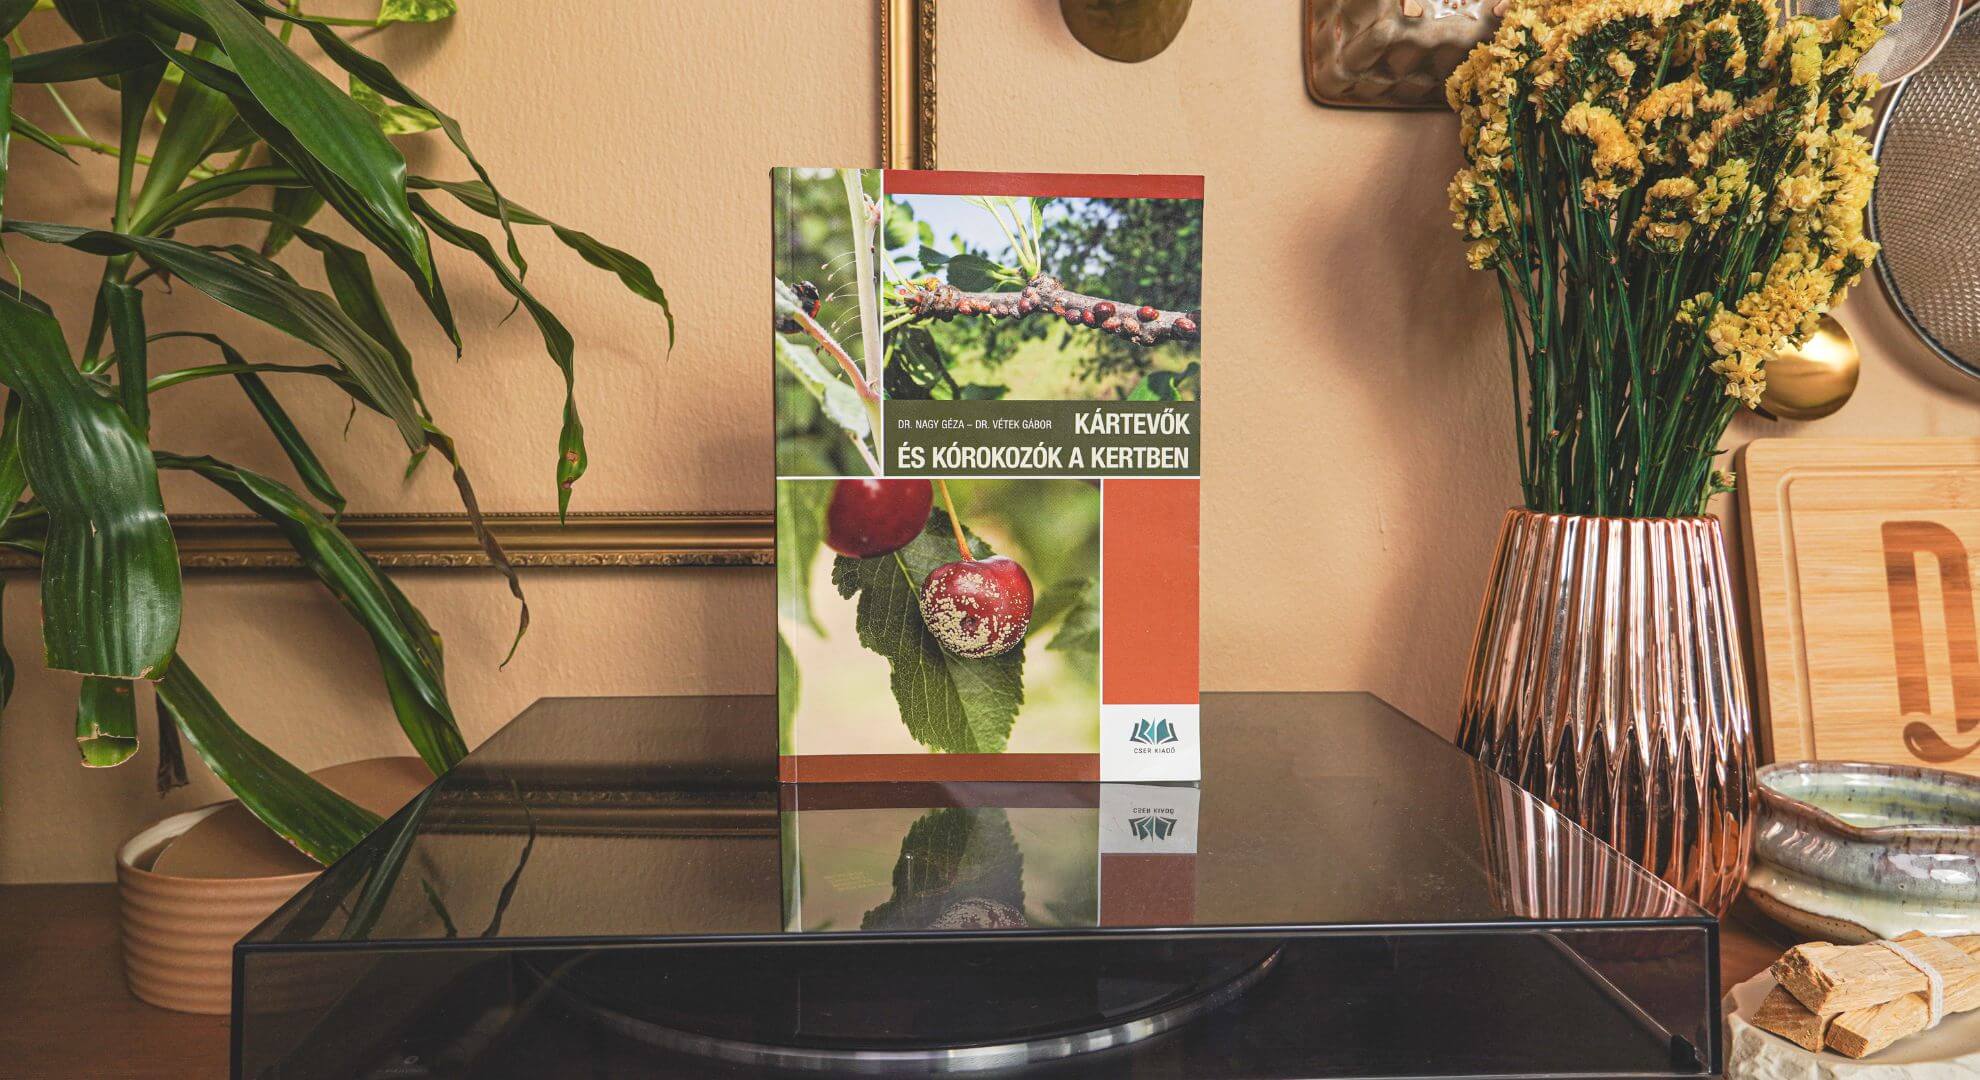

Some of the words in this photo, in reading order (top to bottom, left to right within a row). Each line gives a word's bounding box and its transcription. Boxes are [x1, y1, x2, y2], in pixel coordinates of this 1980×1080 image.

[898, 419, 913, 429] DR.
[915, 419, 939, 429] NAGY
[941, 418, 965, 429] GÉZA
[975, 419, 991, 429] DR.
[992, 418, 1020, 429] VÉTEK
[1022, 418, 1052, 430] GÁBOR
[1074, 408, 1191, 435] KÁRTEVŐK
[897, 441, 926, 469] ÉS
[932, 441, 1064, 469] KÓROKOZÓK
[1068, 446, 1086, 469] A
[1091, 446, 1189, 469] KERTBEN
